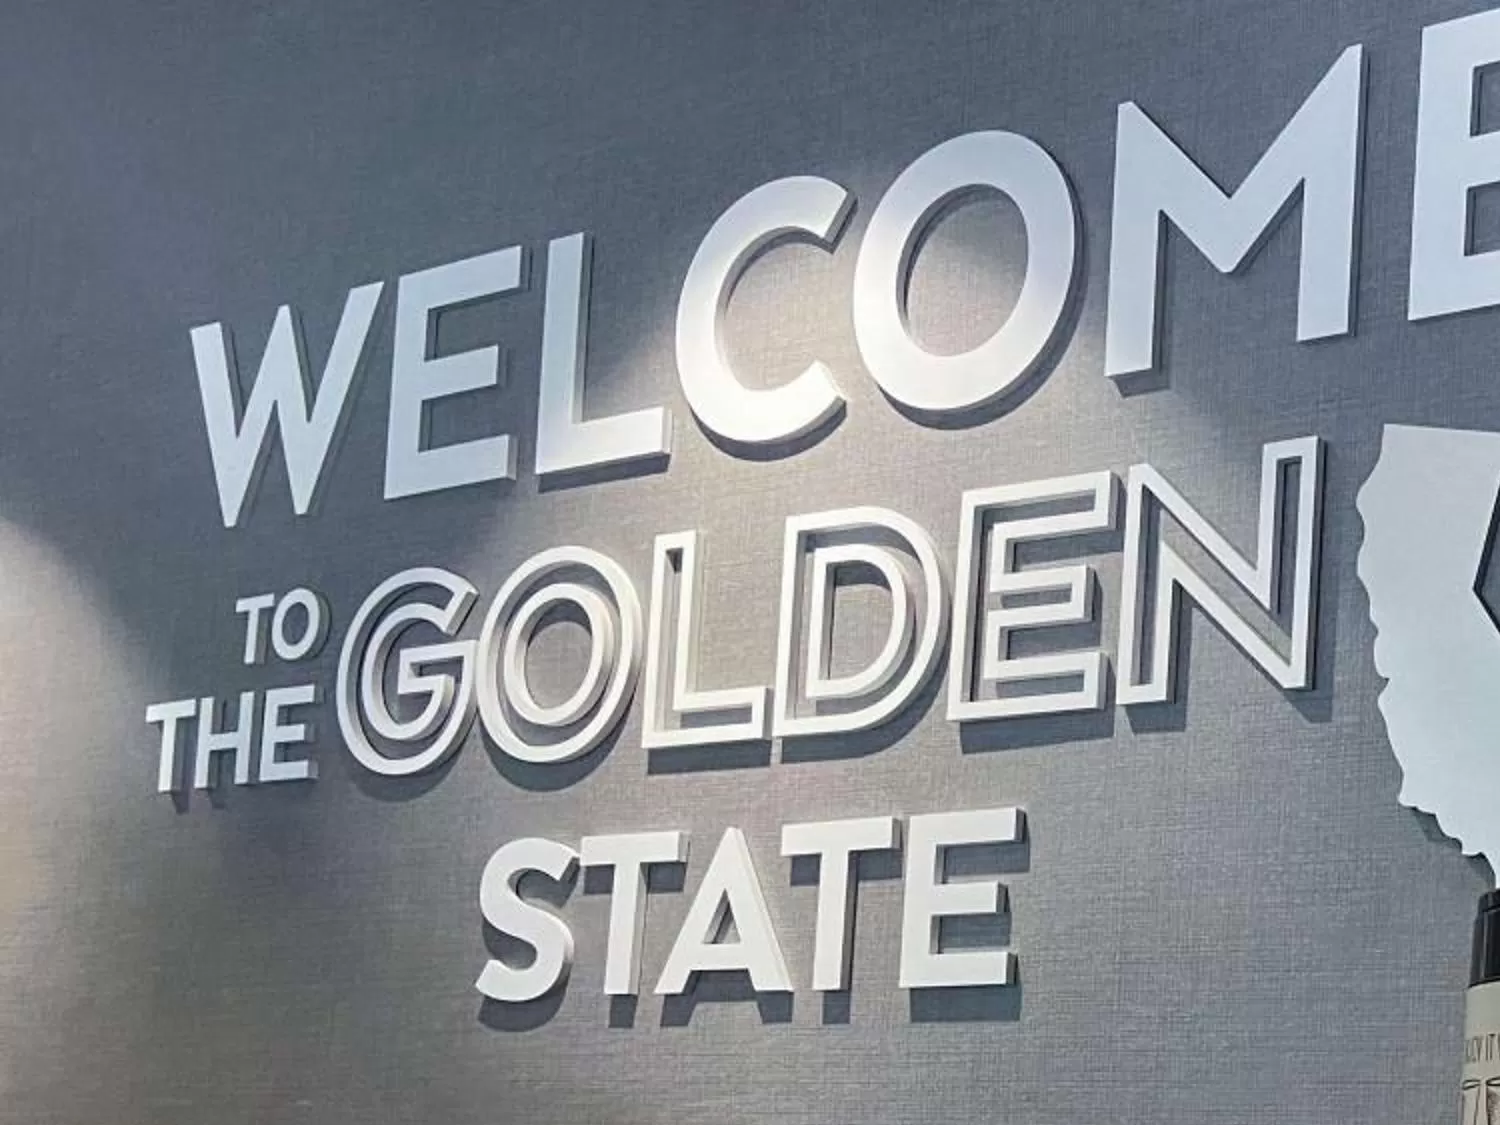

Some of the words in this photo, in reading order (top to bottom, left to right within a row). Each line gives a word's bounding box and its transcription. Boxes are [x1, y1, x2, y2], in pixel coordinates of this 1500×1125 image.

[146, 684, 316, 793] THE
[335, 435, 1322, 775] GOLDEN
[235, 587, 325, 666] TO
[475, 807, 1024, 1001] STATE
